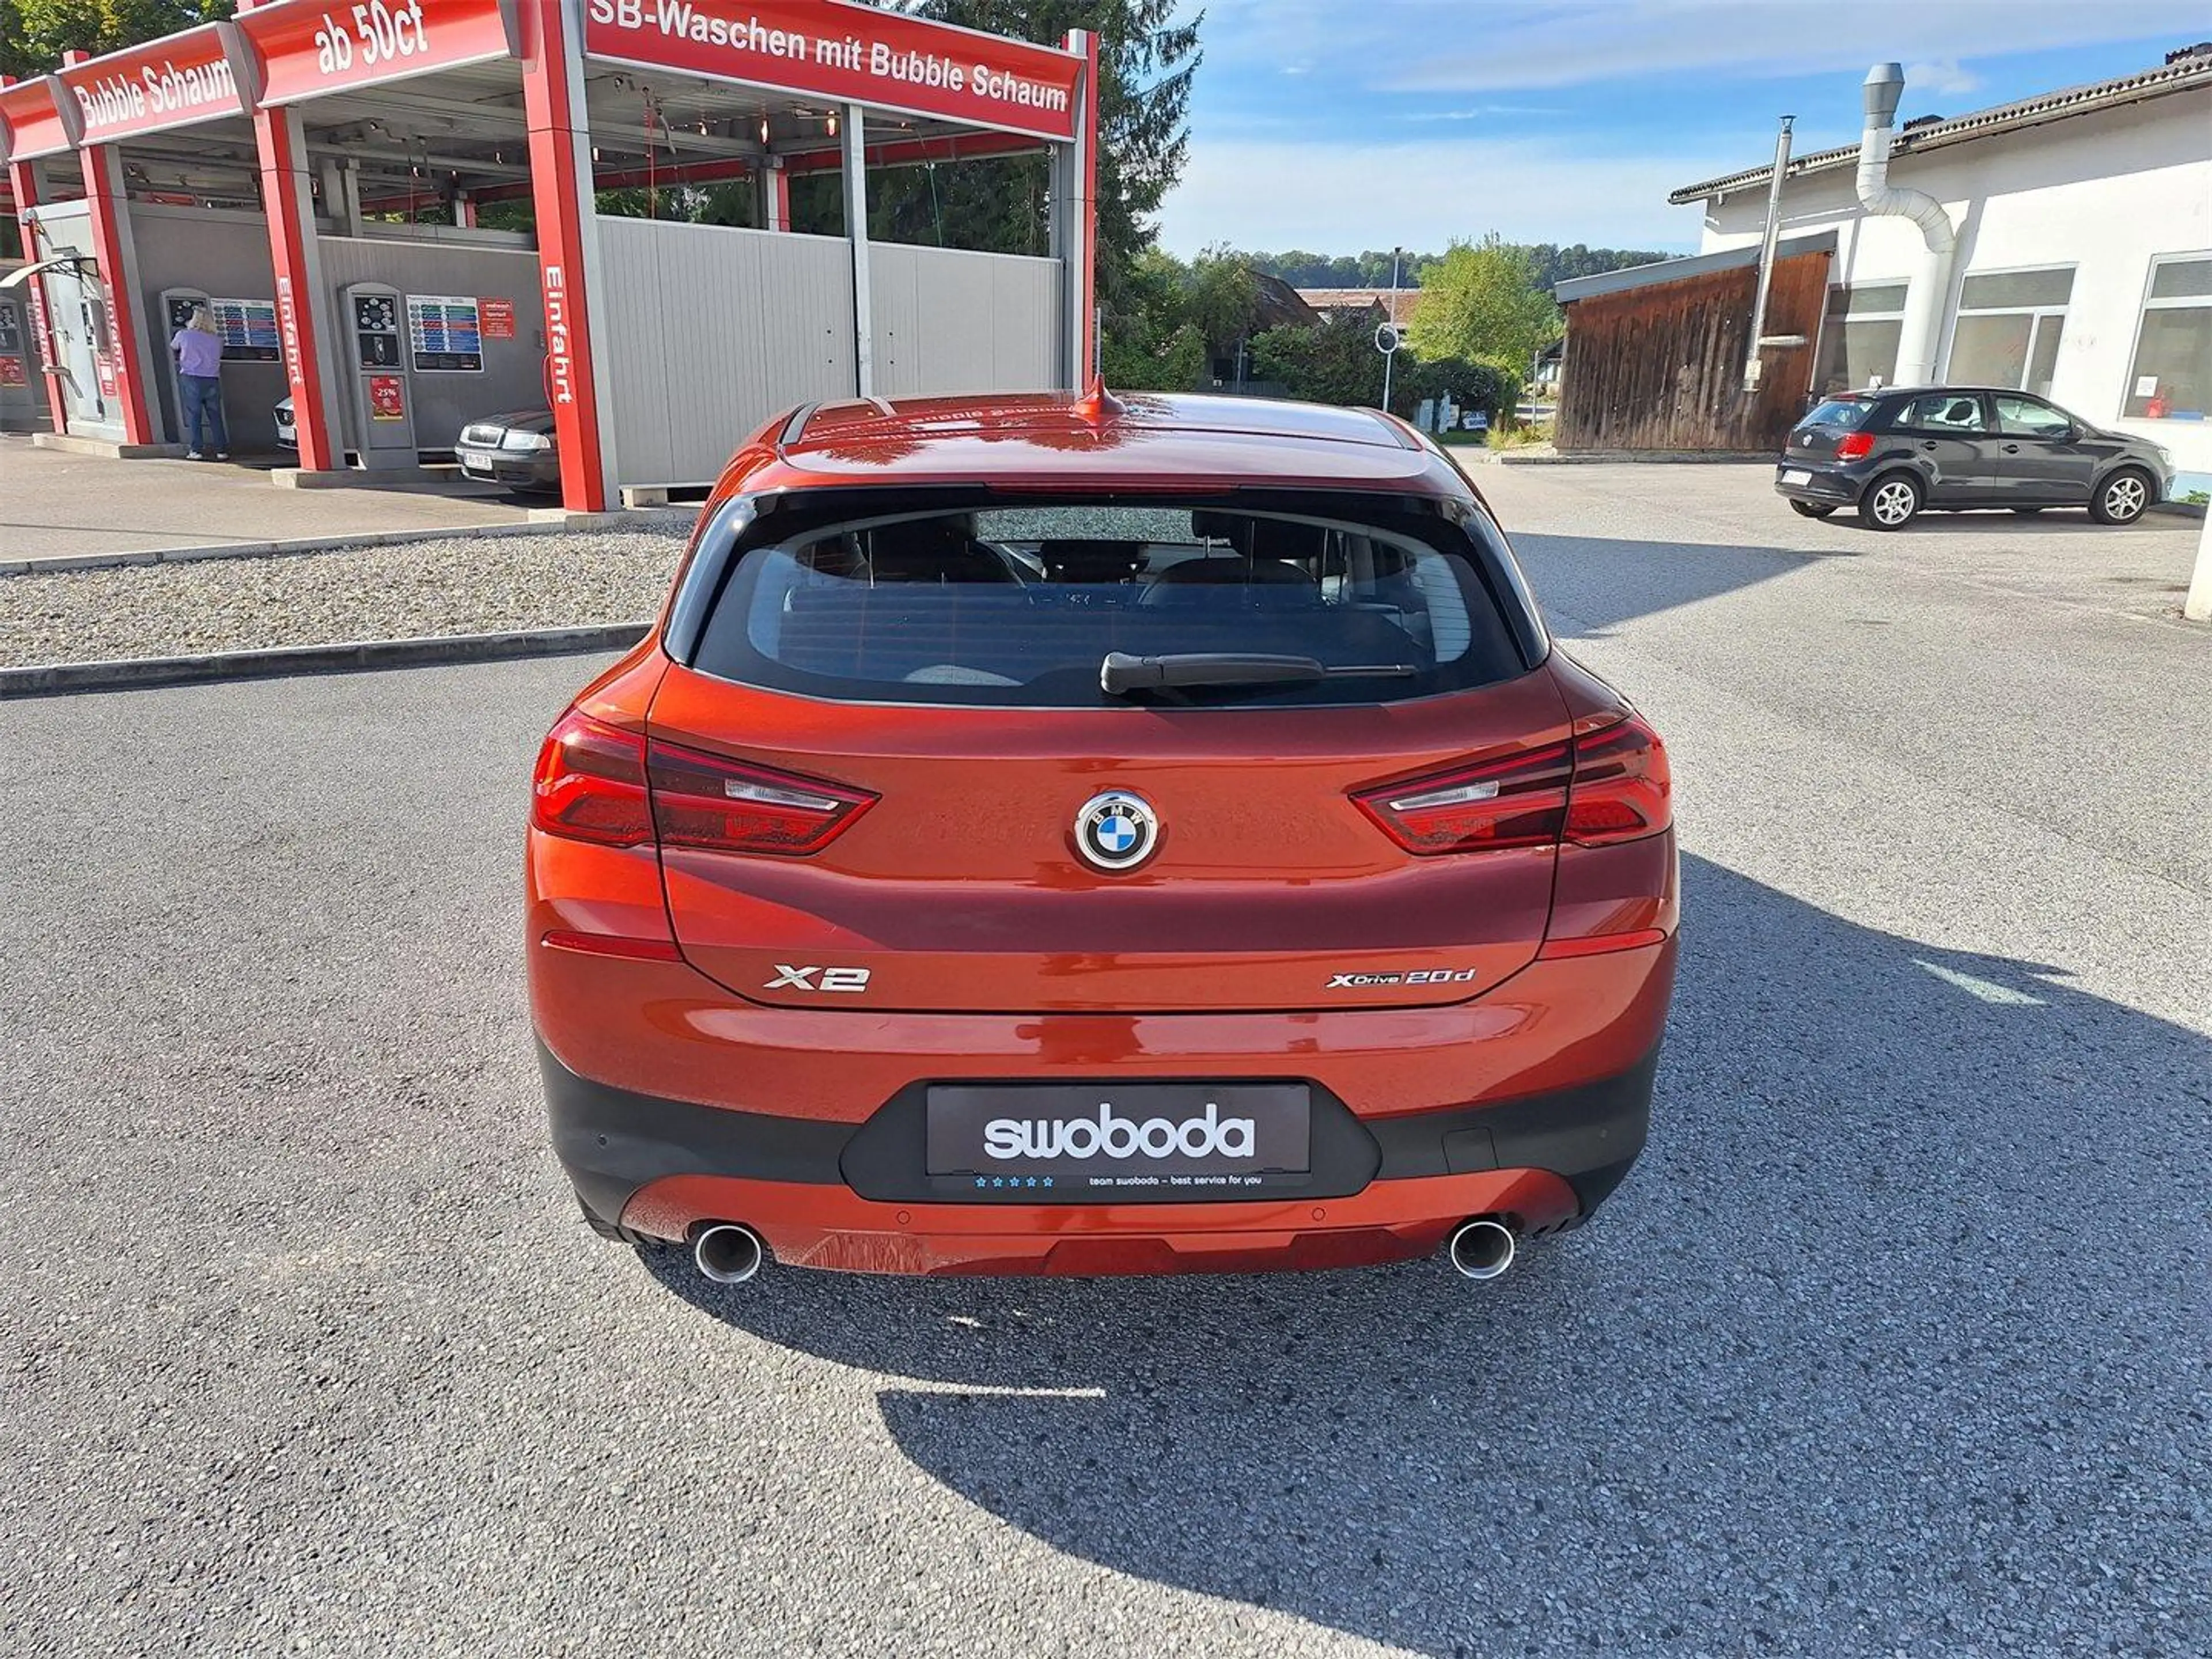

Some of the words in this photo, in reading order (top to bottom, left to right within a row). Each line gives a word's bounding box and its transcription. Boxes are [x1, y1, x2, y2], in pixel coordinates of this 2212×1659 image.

[315, 13, 353, 74] ab
[352, 0, 429, 64] 50ct
[589, 0, 806, 60] SB-Waschen
[816, 35, 862, 71] mit
[870, 42, 964, 92] Bubble
[971, 65, 1066, 112] Schaum
[74, 74, 146, 130] Bubble
[142, 58, 237, 114] Schaum
[279, 277, 302, 384] Einfahrt
[546, 266, 573, 403] Einfahrt
[1092, 805, 1143, 824] BMW
[763, 964, 871, 992] X2
[1406, 969, 1476, 984] 20d
[983, 1103, 1255, 1160] swoboda
[1089, 1177, 1113, 1185] team
[1116, 1176, 1159, 1185] swoboda
[1170, 1175, 1191, 1185] best
[1194, 1176, 1226, 1185] service
[1229, 1175, 1241, 1185] for
[1244, 1176, 1262, 1186] you
